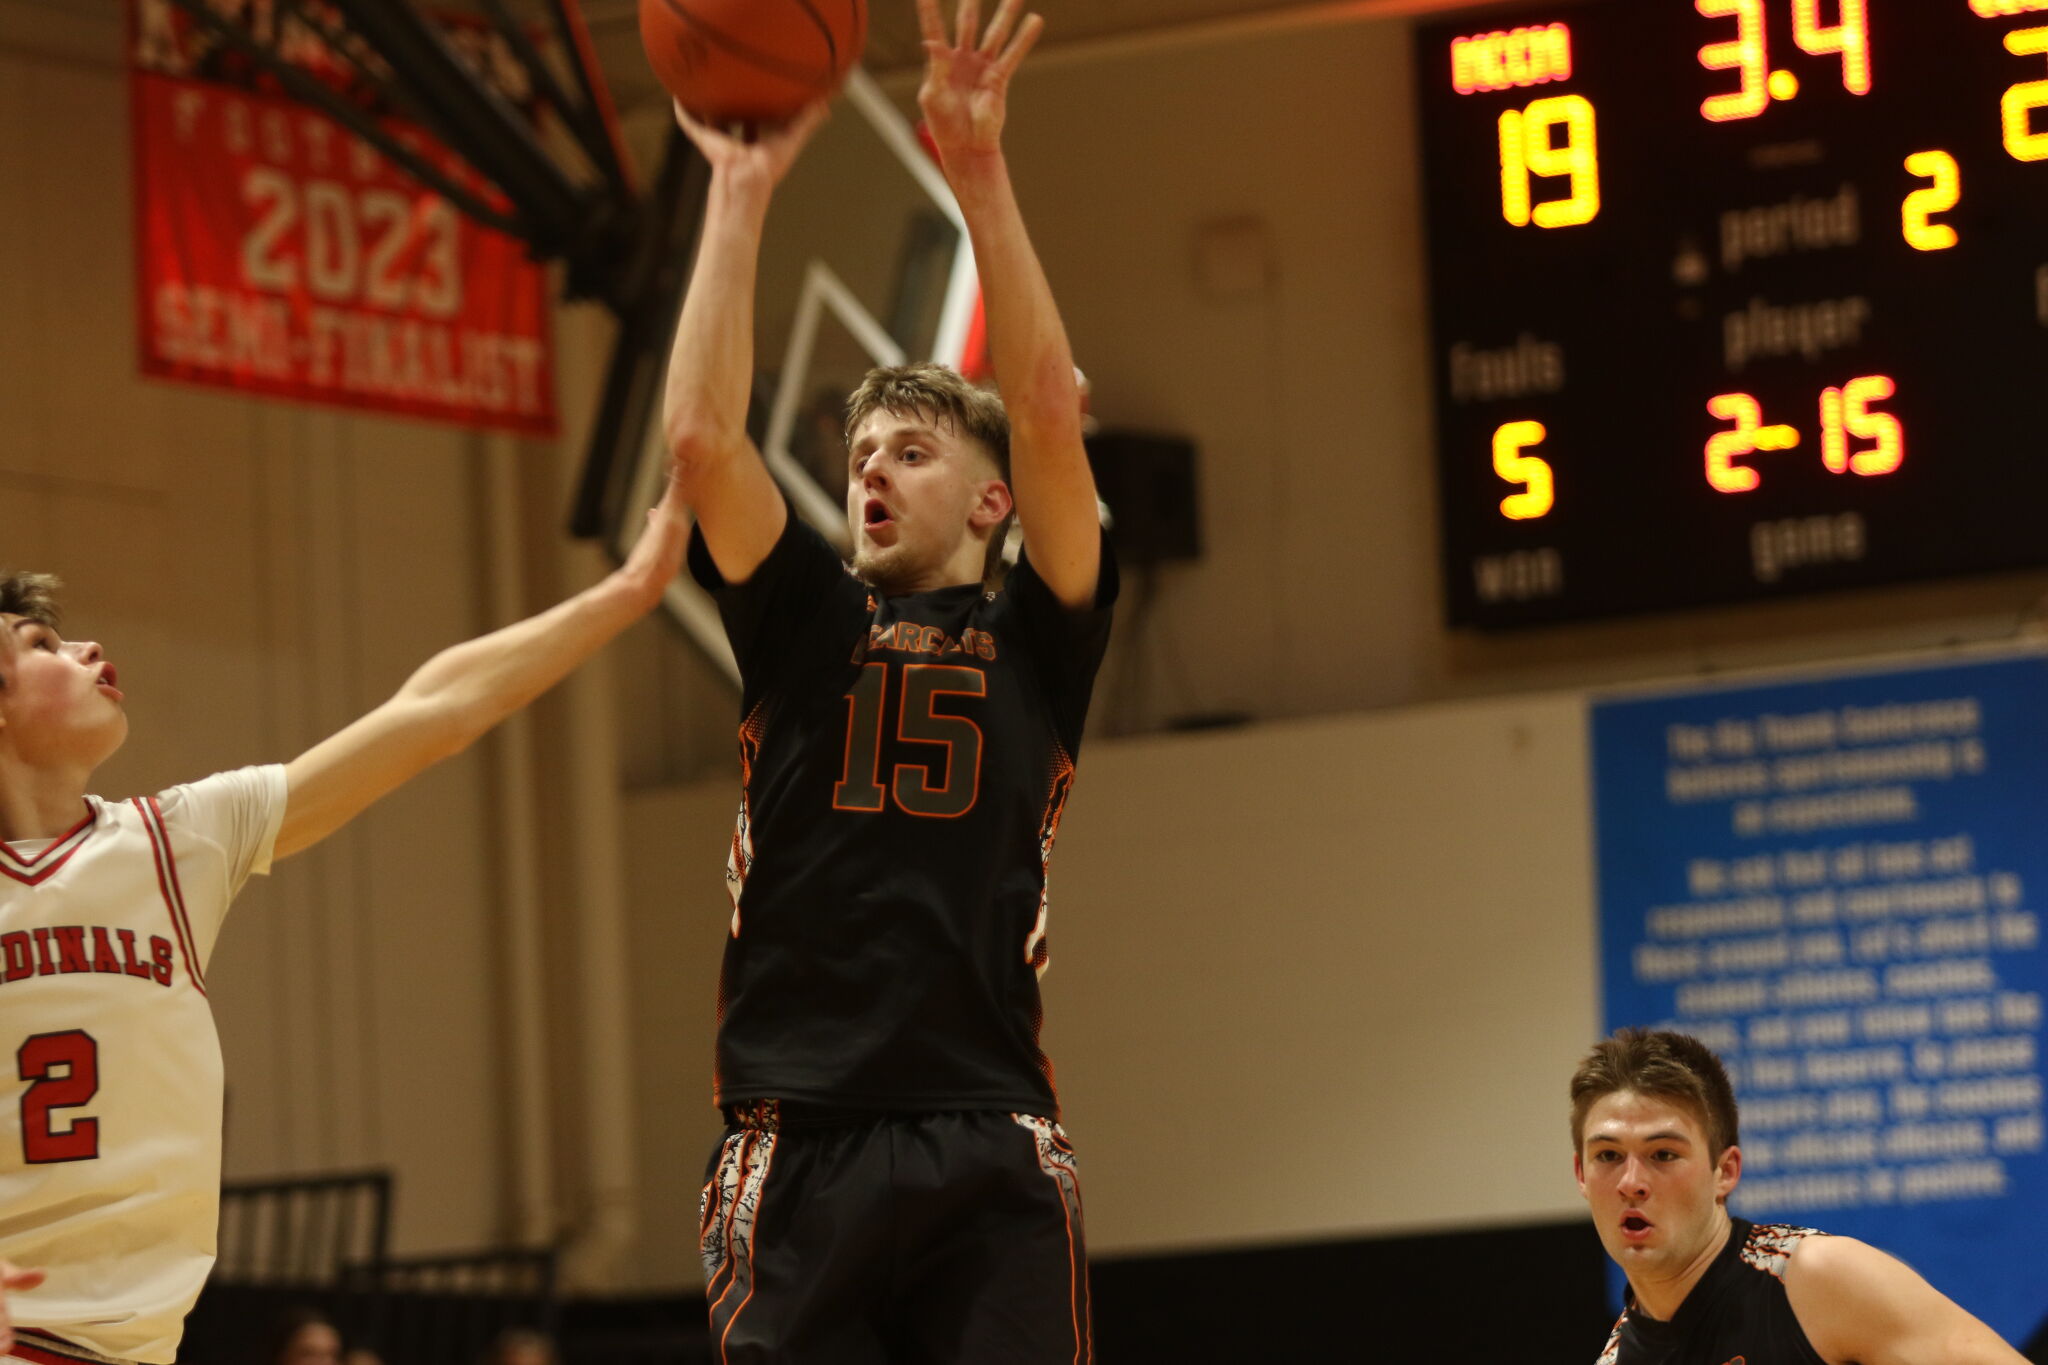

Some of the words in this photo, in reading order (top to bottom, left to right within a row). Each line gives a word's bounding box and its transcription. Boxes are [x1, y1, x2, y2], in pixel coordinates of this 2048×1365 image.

[1499, 95, 1599, 229] 19
[1902, 150, 1961, 251] 2
[243, 168, 460, 318] 2023
[1720, 186, 1858, 270] period
[155, 280, 542, 413] SEMI-FINALIST
[1723, 299, 1868, 368] player
[1492, 420, 1554, 520] 5
[1751, 513, 1865, 580] game
[832, 662, 986, 819] 15
[0, 926, 173, 987] DINALS
[17, 1029, 99, 1164] 2
